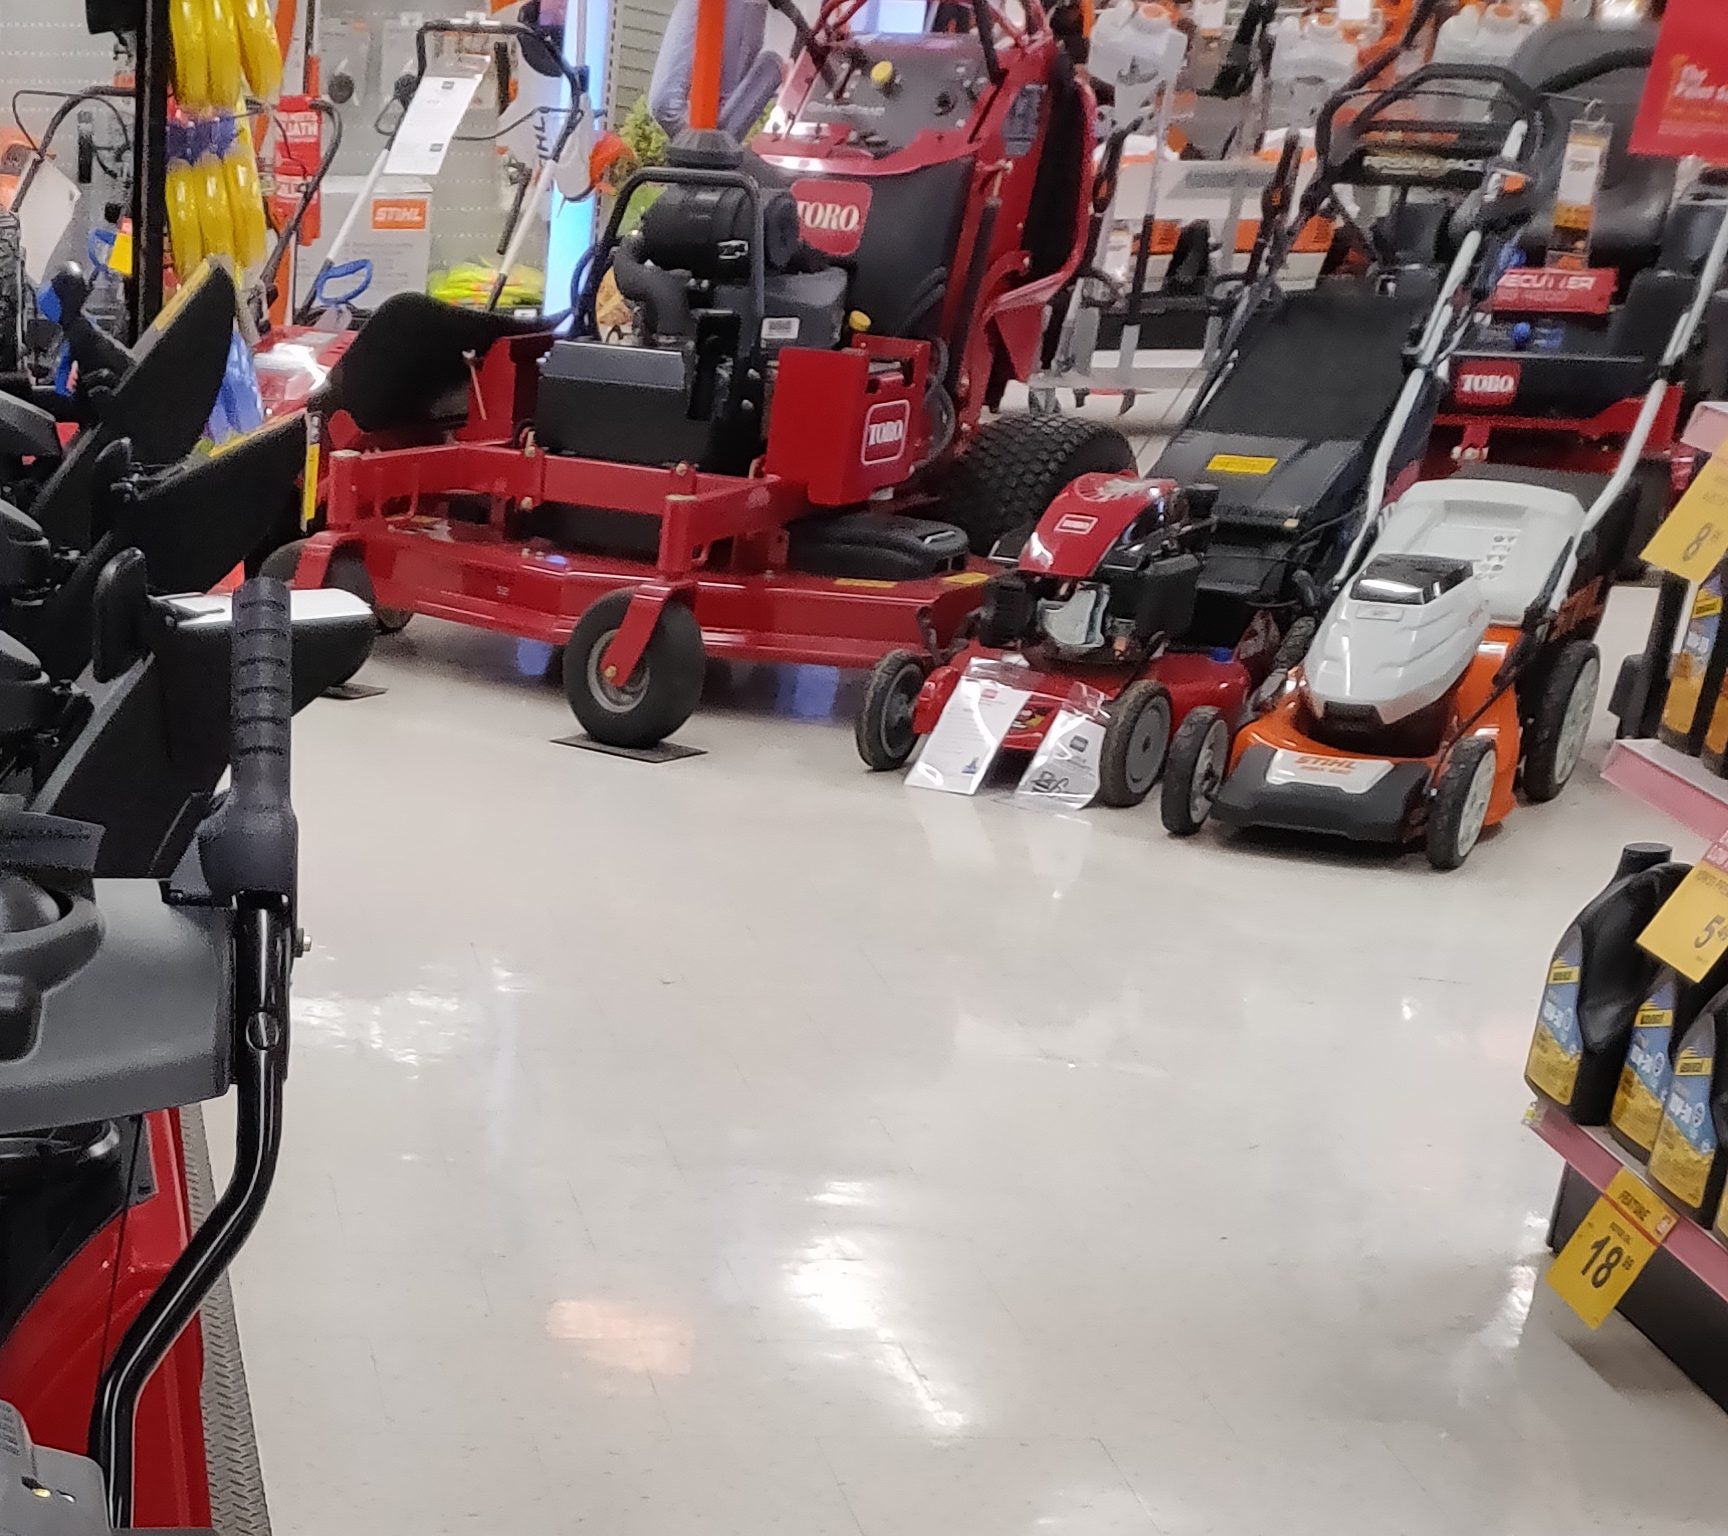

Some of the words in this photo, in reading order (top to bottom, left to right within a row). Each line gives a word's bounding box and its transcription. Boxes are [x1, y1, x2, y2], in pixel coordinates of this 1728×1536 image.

[375, 206, 423, 222] STIHL
[797, 201, 861, 232] TORO
[1461, 374, 1515, 393] TORO
[1295, 755, 1357, 768] STIHL
[1580, 1235, 1625, 1288] 18
